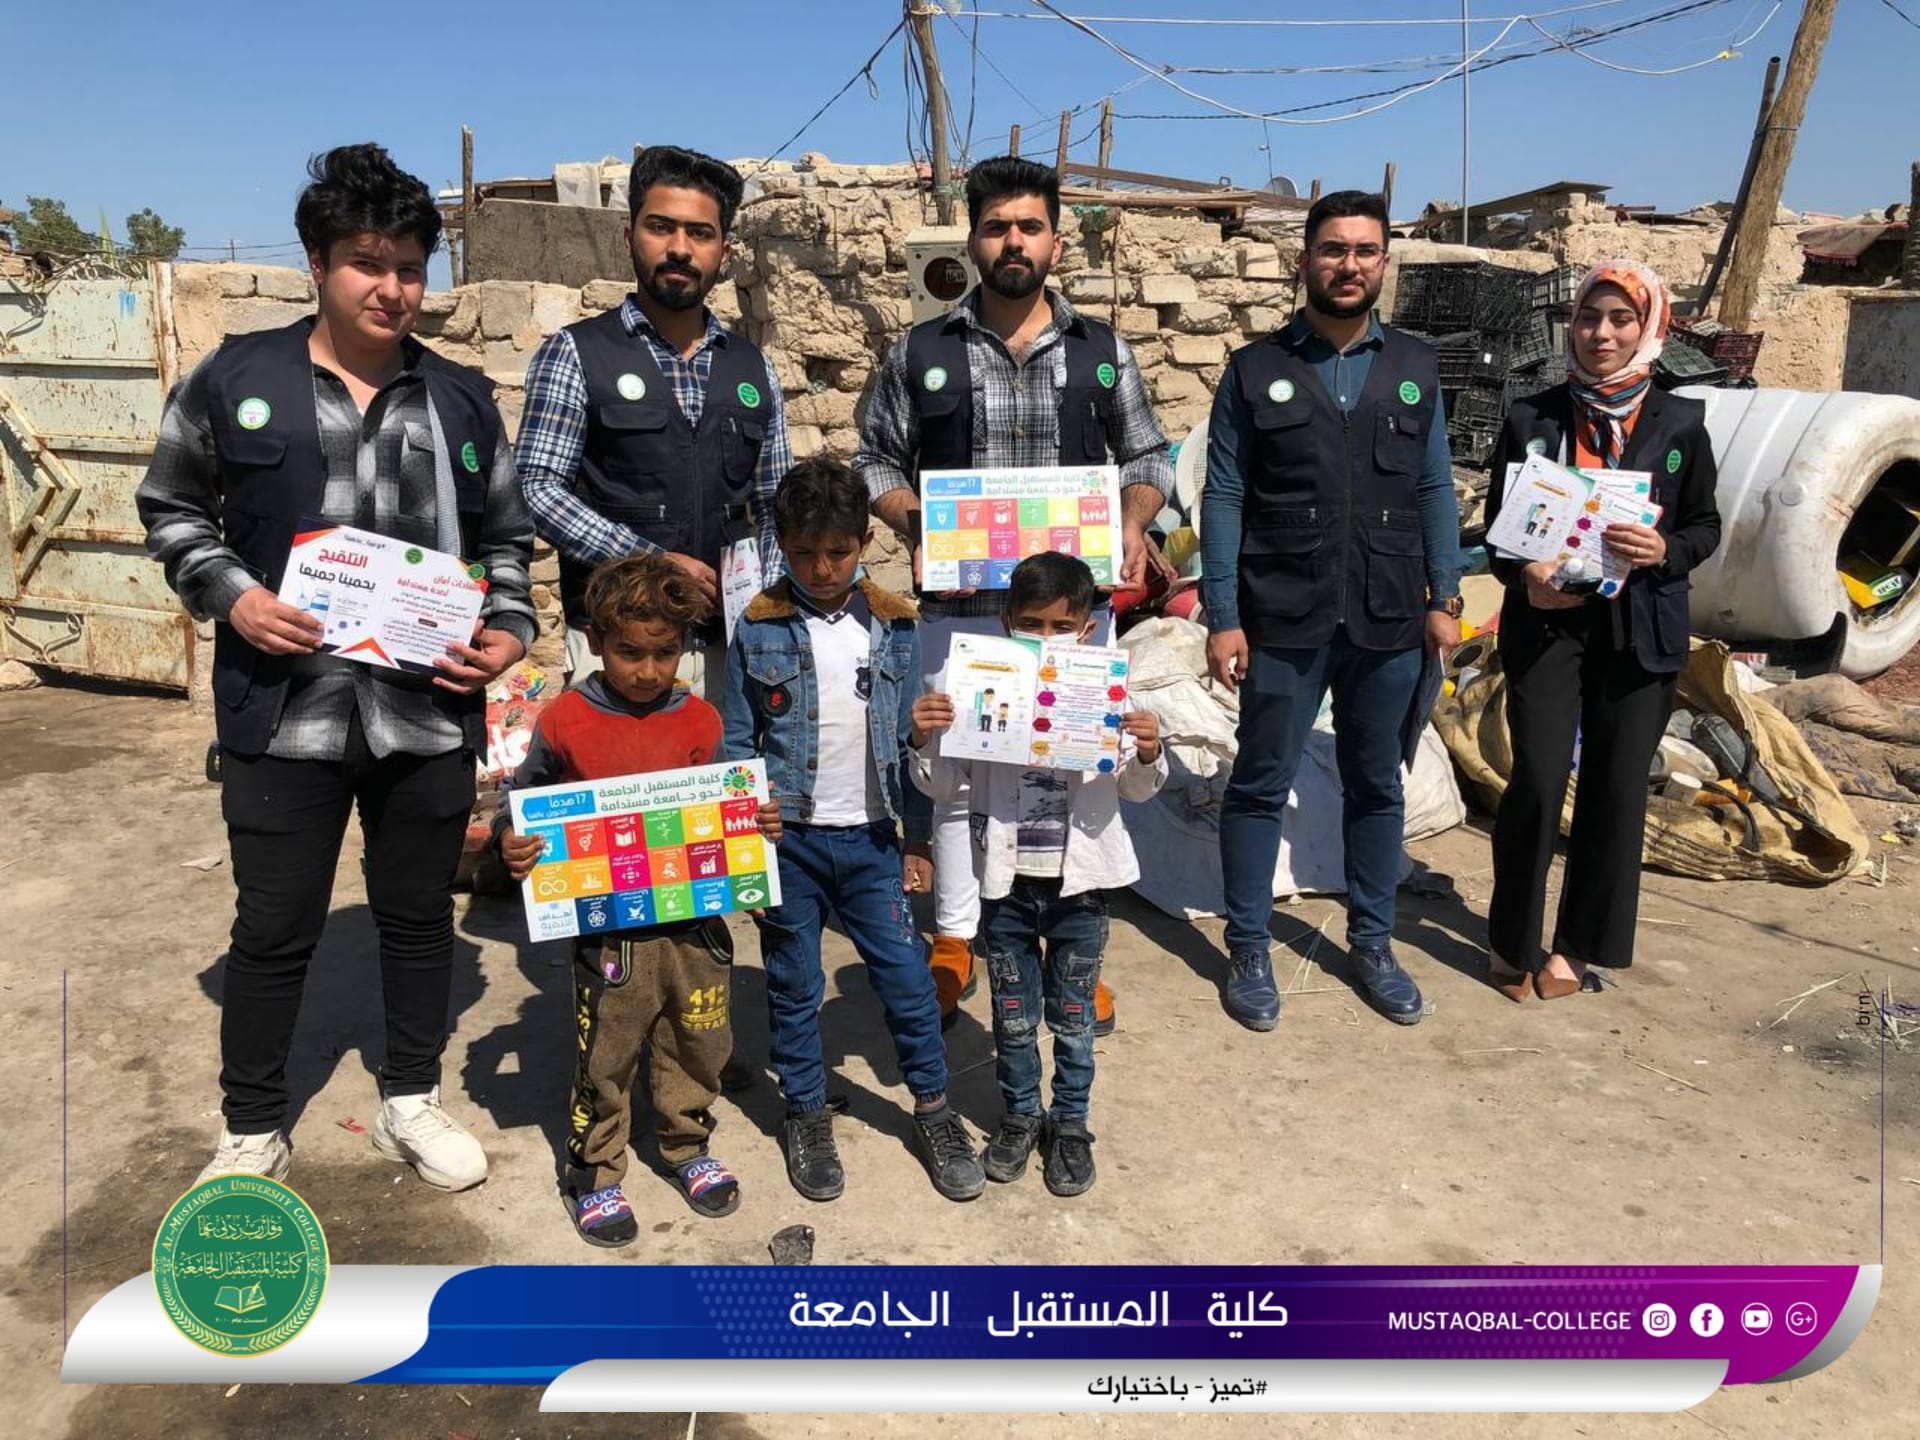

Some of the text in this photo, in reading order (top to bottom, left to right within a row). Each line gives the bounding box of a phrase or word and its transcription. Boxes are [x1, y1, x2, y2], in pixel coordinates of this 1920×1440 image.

[318, 547, 368, 569] التلقيح
[298, 561, 377, 593] يحمينا جميعا
[599, 772, 721, 798] كلية المستقبل الجامعة
[575, 792, 586, 805] 17
[600, 798, 650, 812] مستدامة
